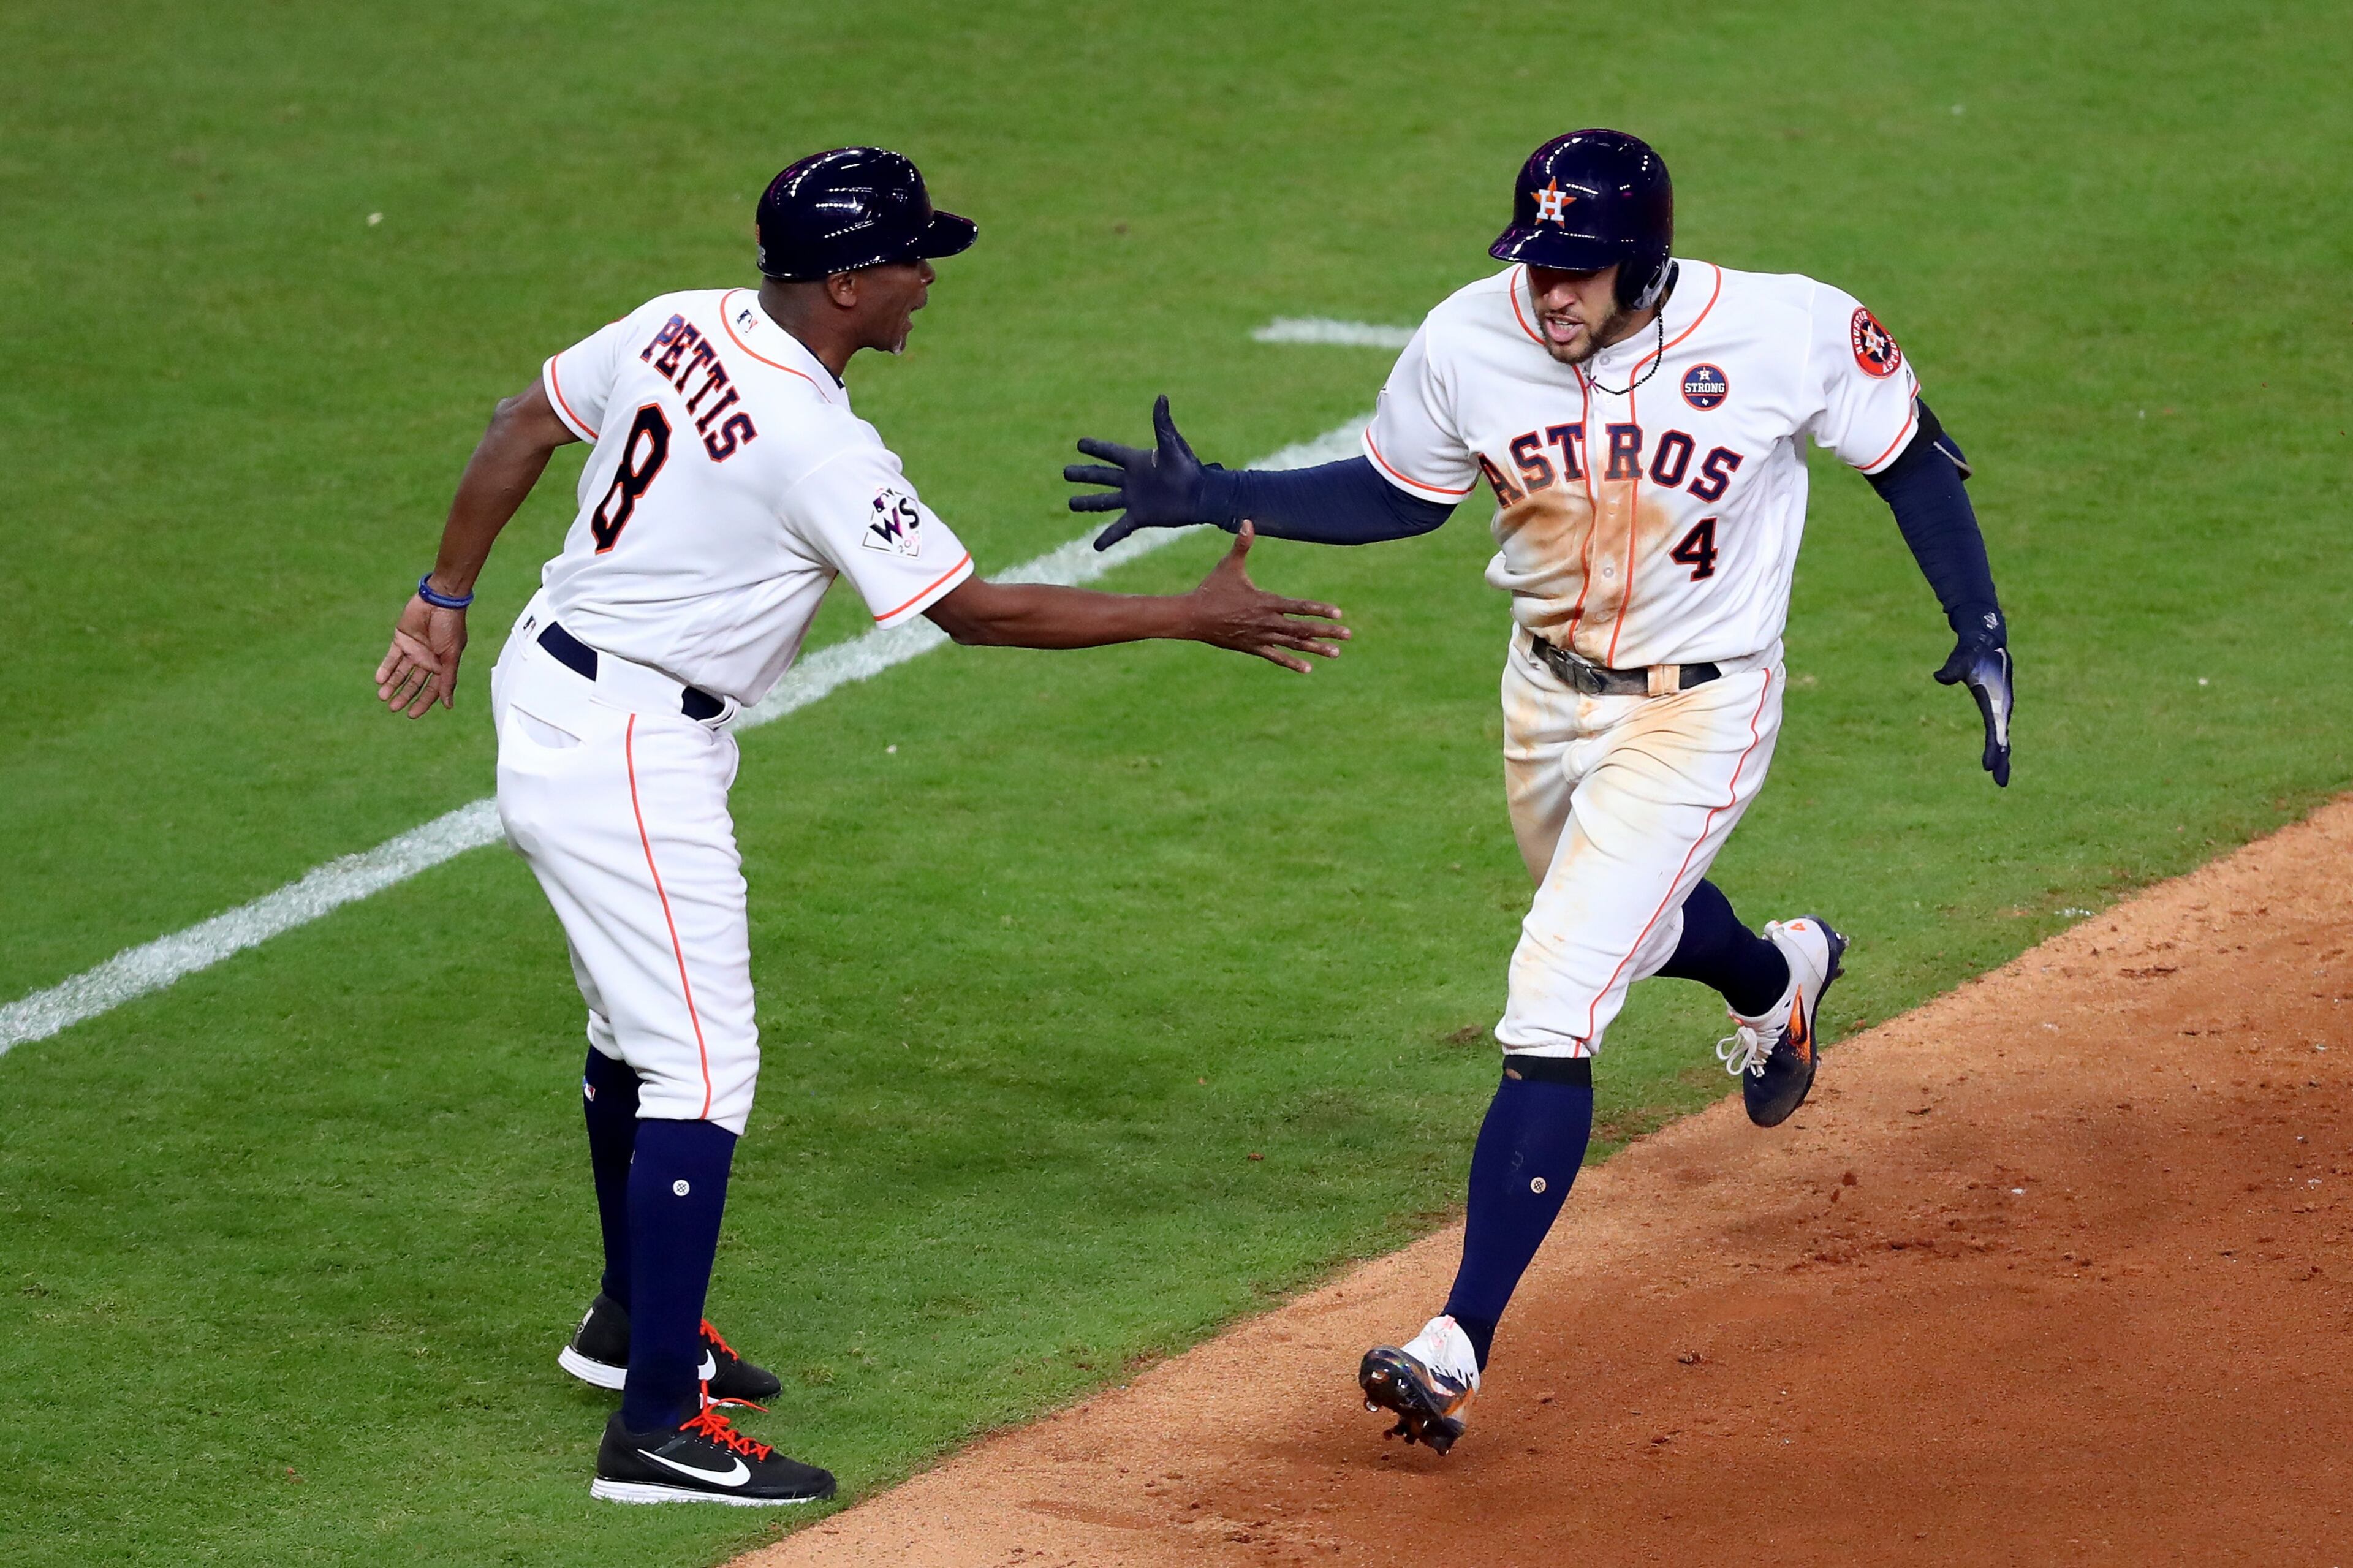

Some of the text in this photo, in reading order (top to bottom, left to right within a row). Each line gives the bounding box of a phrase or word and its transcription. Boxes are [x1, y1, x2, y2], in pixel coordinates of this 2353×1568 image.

[1537, 189, 1567, 222] H
[1852, 310, 1868, 355] HOUSTON
[640, 313, 758, 463] PETTIS
[1684, 382, 1725, 393] STRONG
[591, 402, 672, 556] 8
[1477, 420, 1745, 510] ASTROS
[869, 497, 920, 545] WS
[1669, 517, 1718, 582] 4
